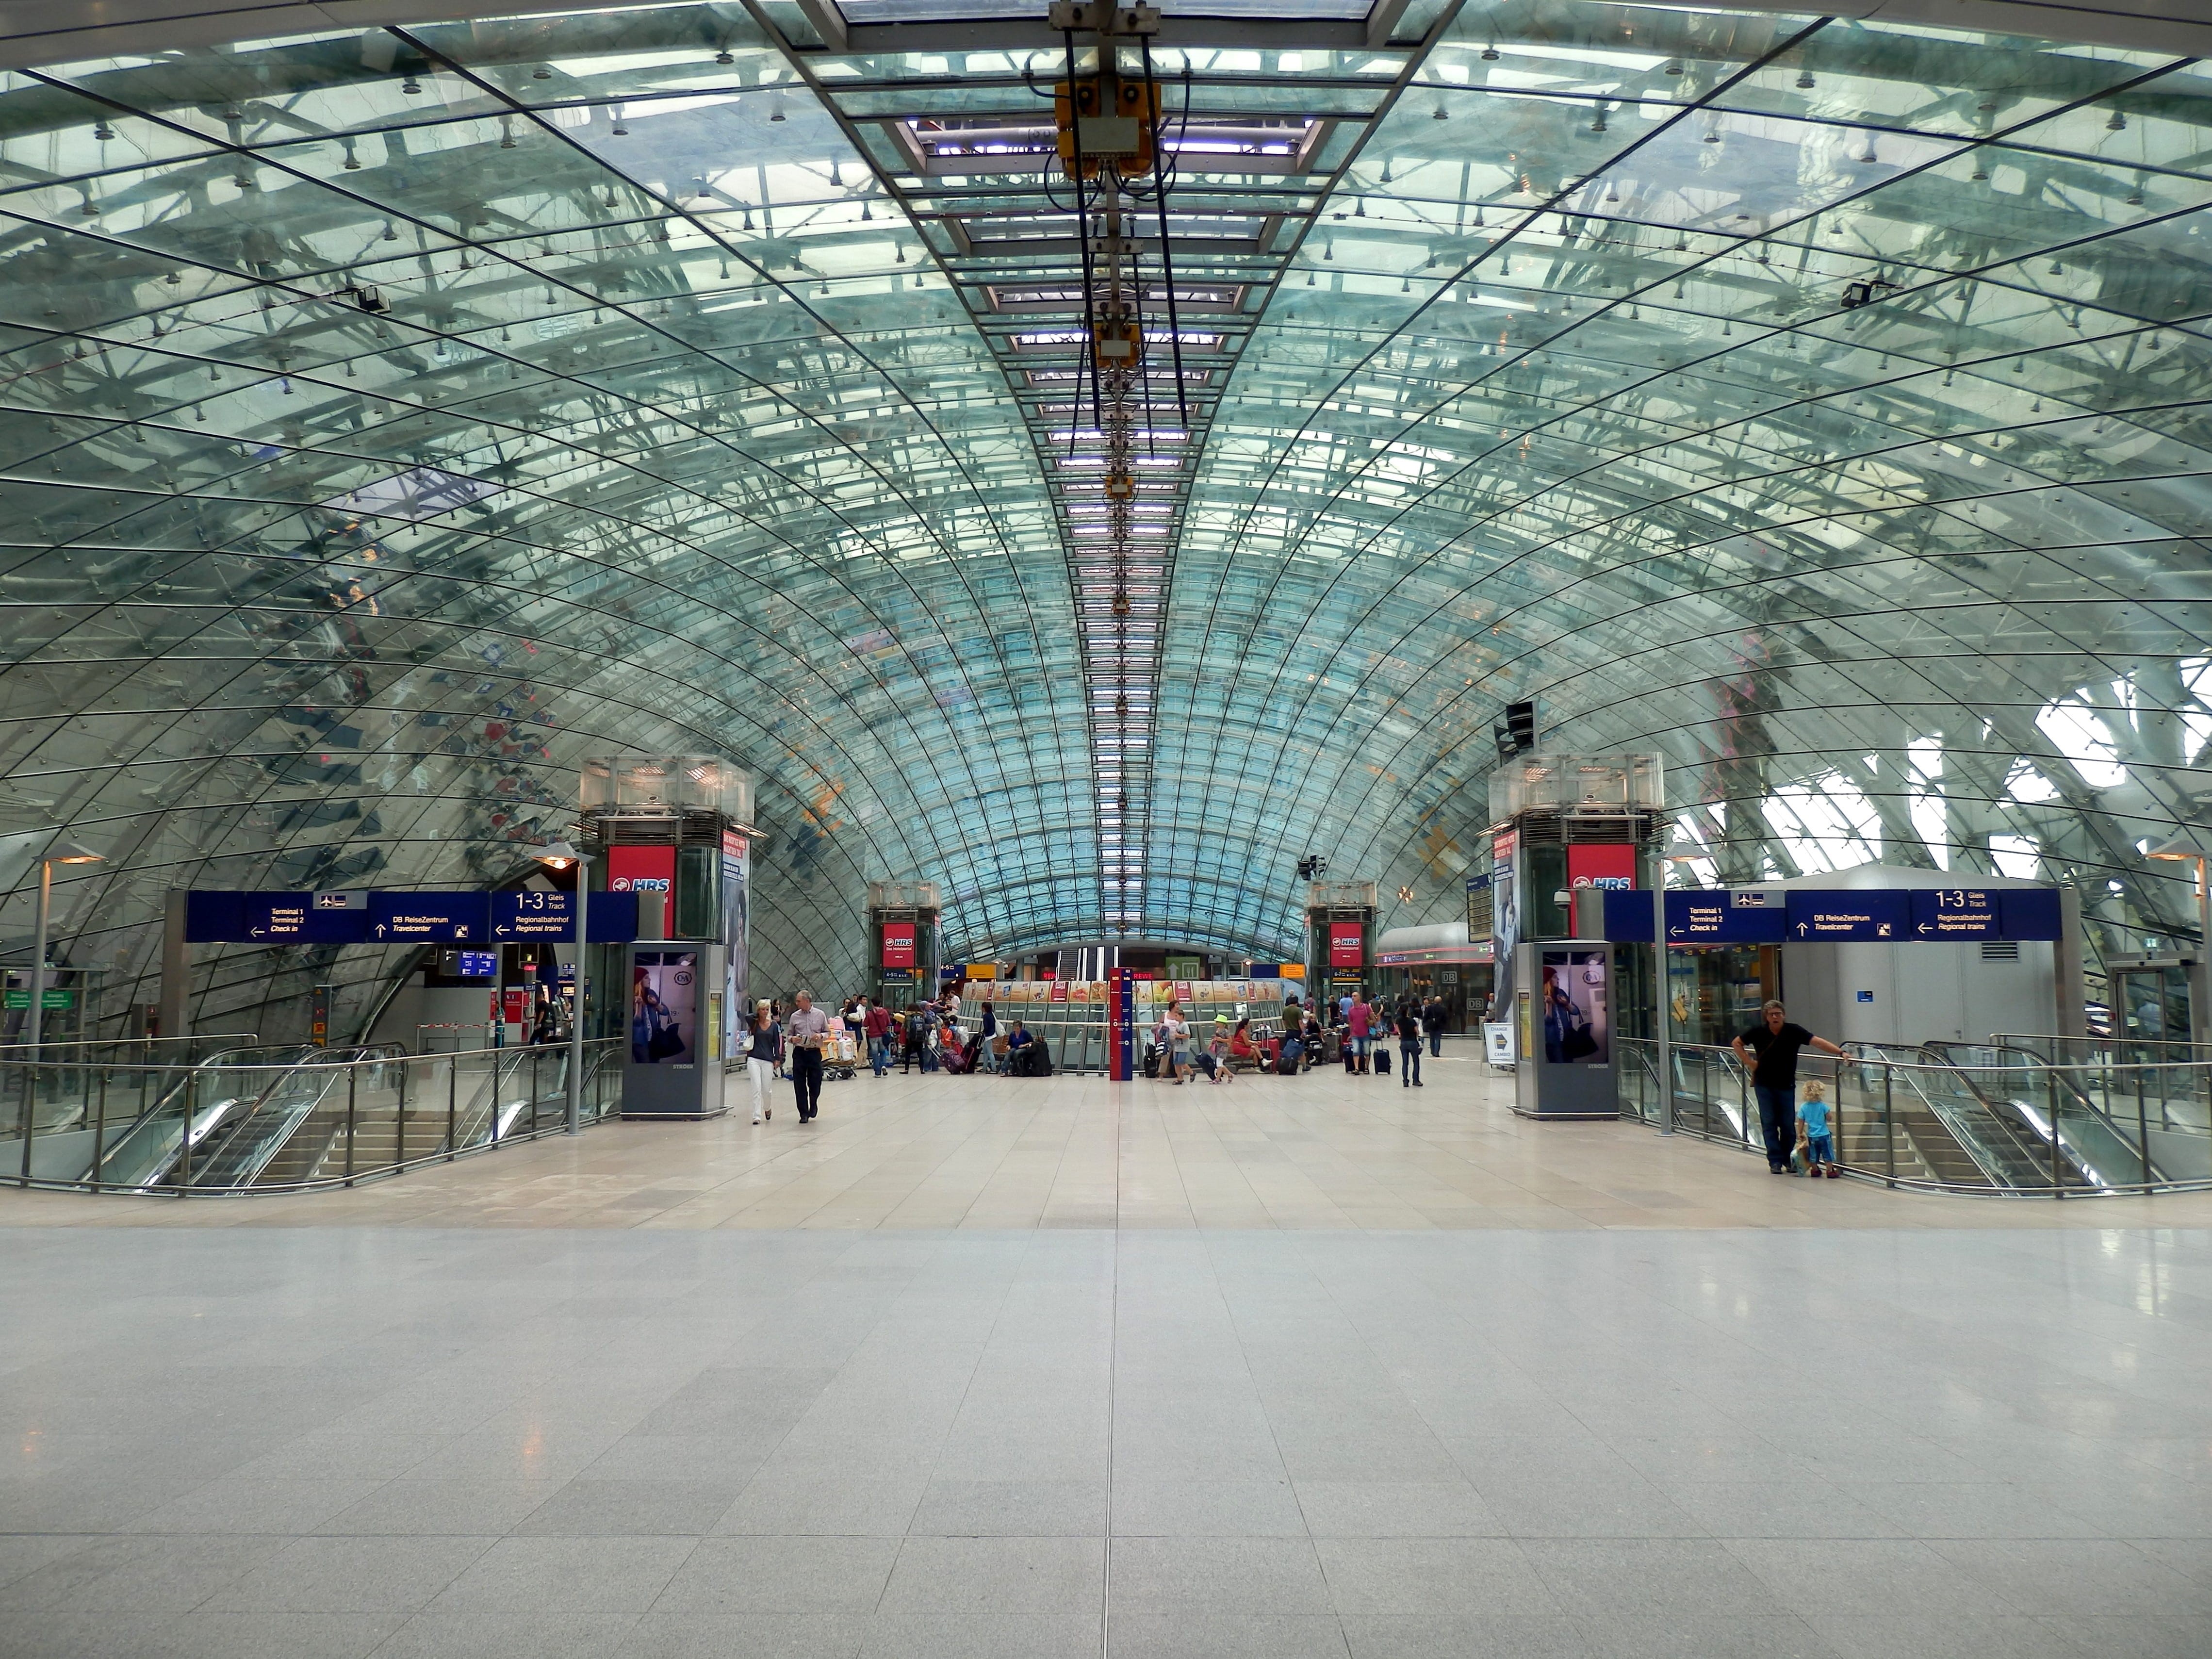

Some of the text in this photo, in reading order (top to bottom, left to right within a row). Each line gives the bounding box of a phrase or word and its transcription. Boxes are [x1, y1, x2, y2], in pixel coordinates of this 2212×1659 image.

[632, 879, 671, 892] HRS
[1593, 877, 1631, 890] HRS
[516, 893, 543, 909] 1-3
[1936, 890, 1965, 907] 1-3
